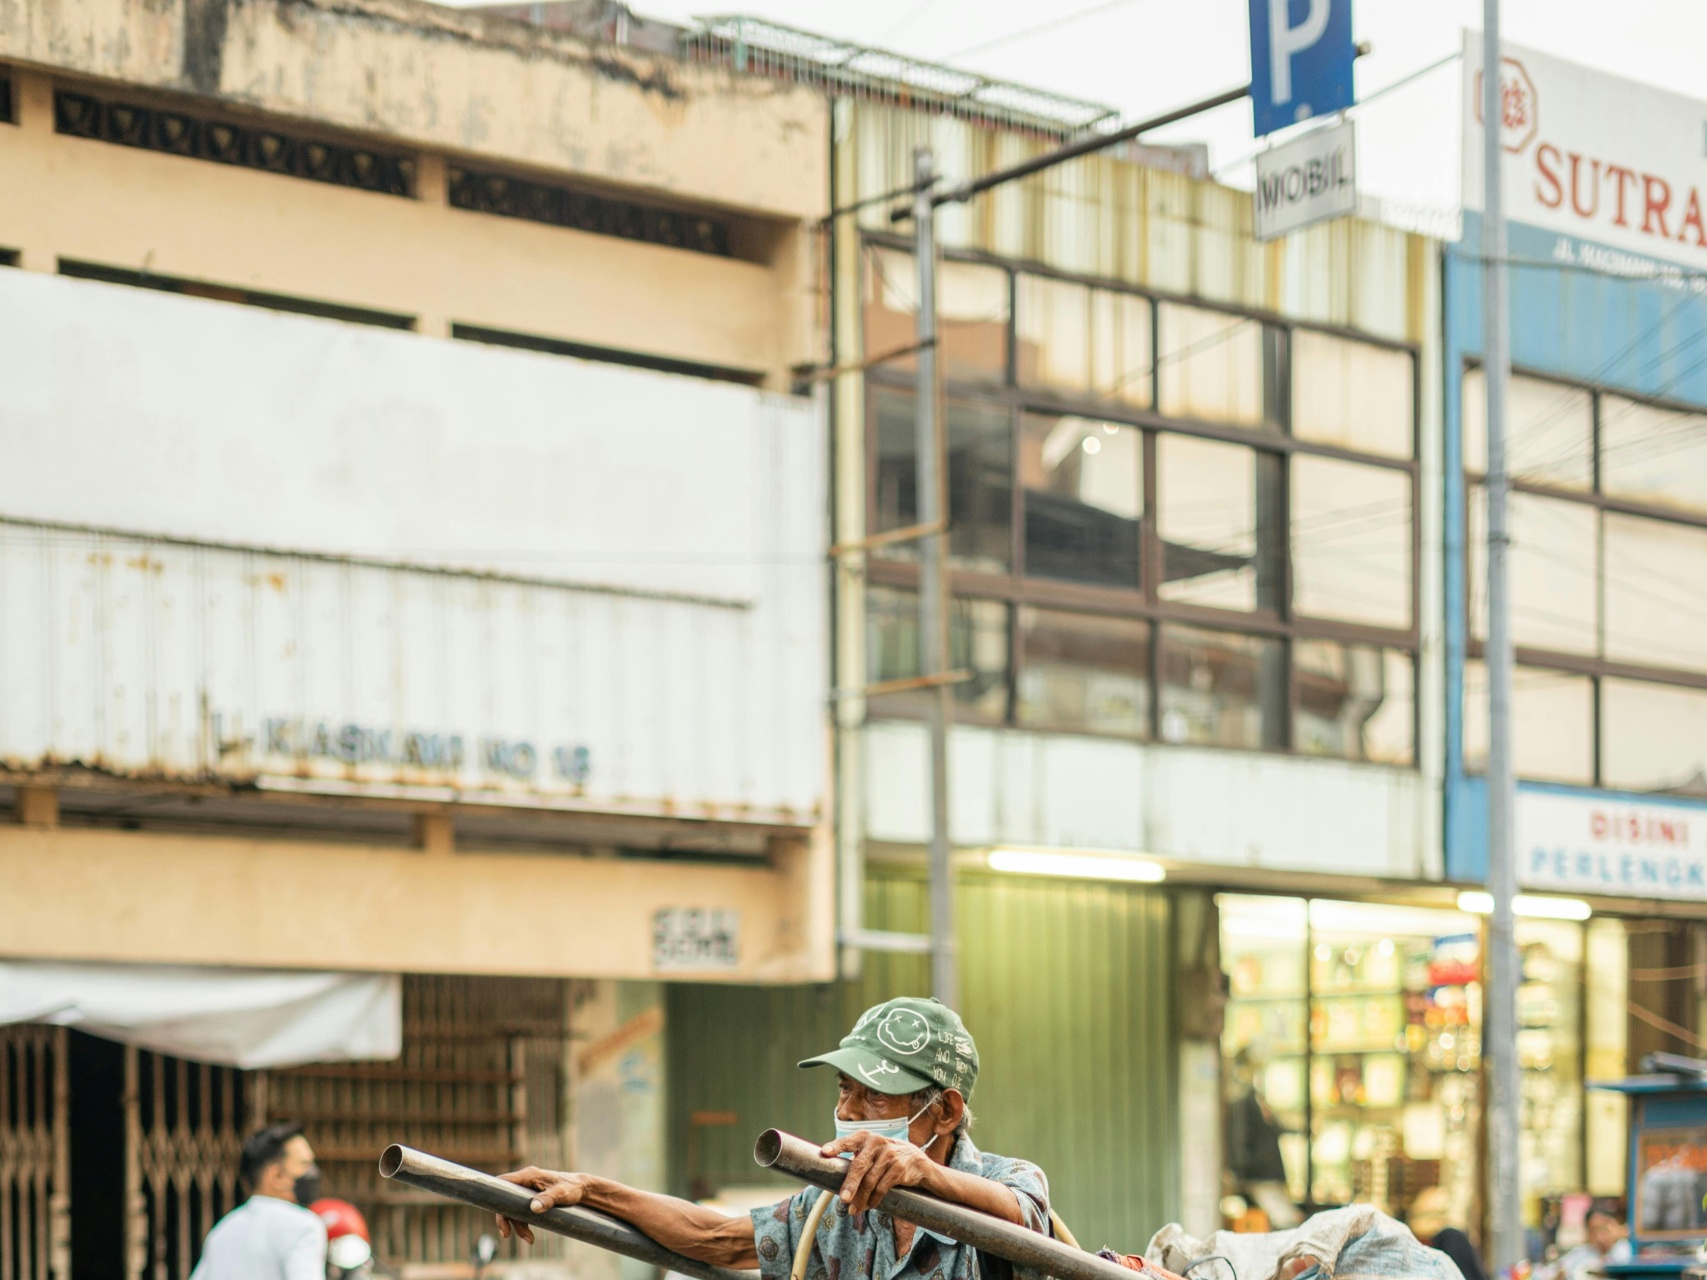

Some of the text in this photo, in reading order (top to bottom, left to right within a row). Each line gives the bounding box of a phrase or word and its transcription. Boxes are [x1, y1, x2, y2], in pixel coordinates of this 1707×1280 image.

[1269, 0, 1331, 106] P
[1256, 144, 1349, 214] MOBIL
[1534, 142, 1707, 249] SUTRA
[1591, 810, 1689, 846] DISINI
[1530, 846, 1705, 886] PERLENGK
[935, 1048, 950, 1064] AND
